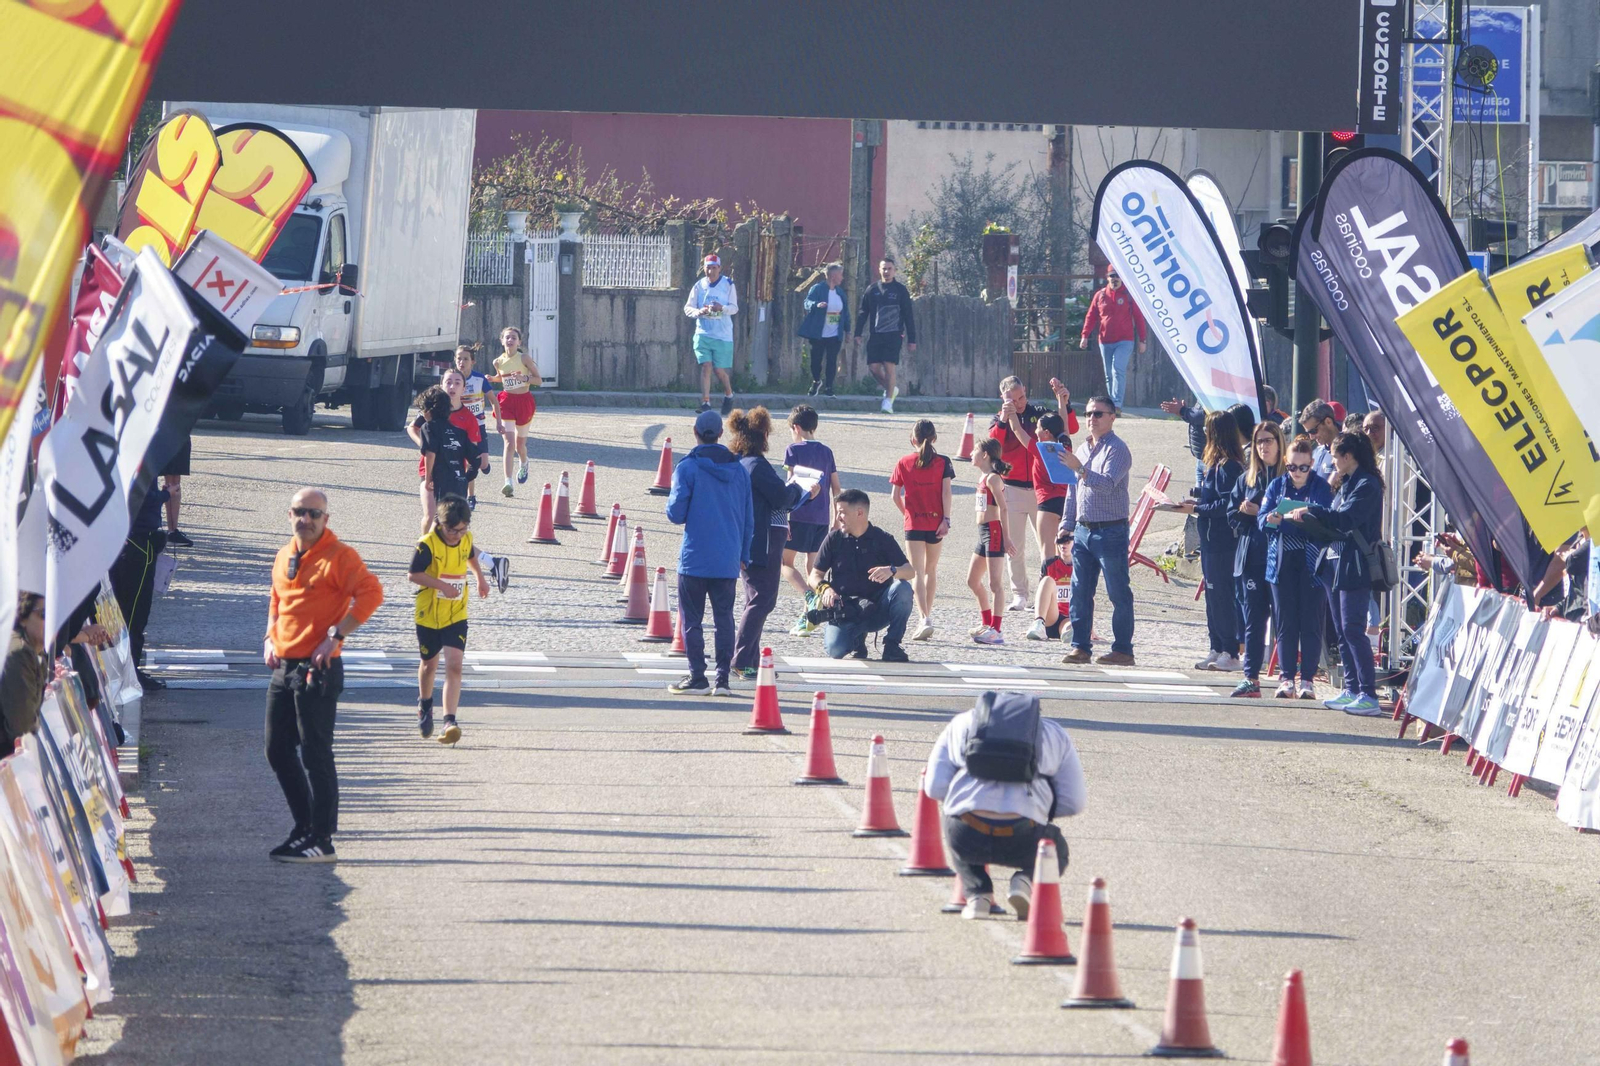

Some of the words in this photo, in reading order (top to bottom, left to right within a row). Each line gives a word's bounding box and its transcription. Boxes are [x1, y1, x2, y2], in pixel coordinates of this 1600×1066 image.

[1372, 11, 1391, 121] CCNORTE
[177, 333, 216, 384] DACIA
[1470, 312, 1519, 381] MANTENIMIENTO
[1432, 307, 1548, 474] ELECPOR
[1520, 388, 1562, 453] INSTALACIONES
